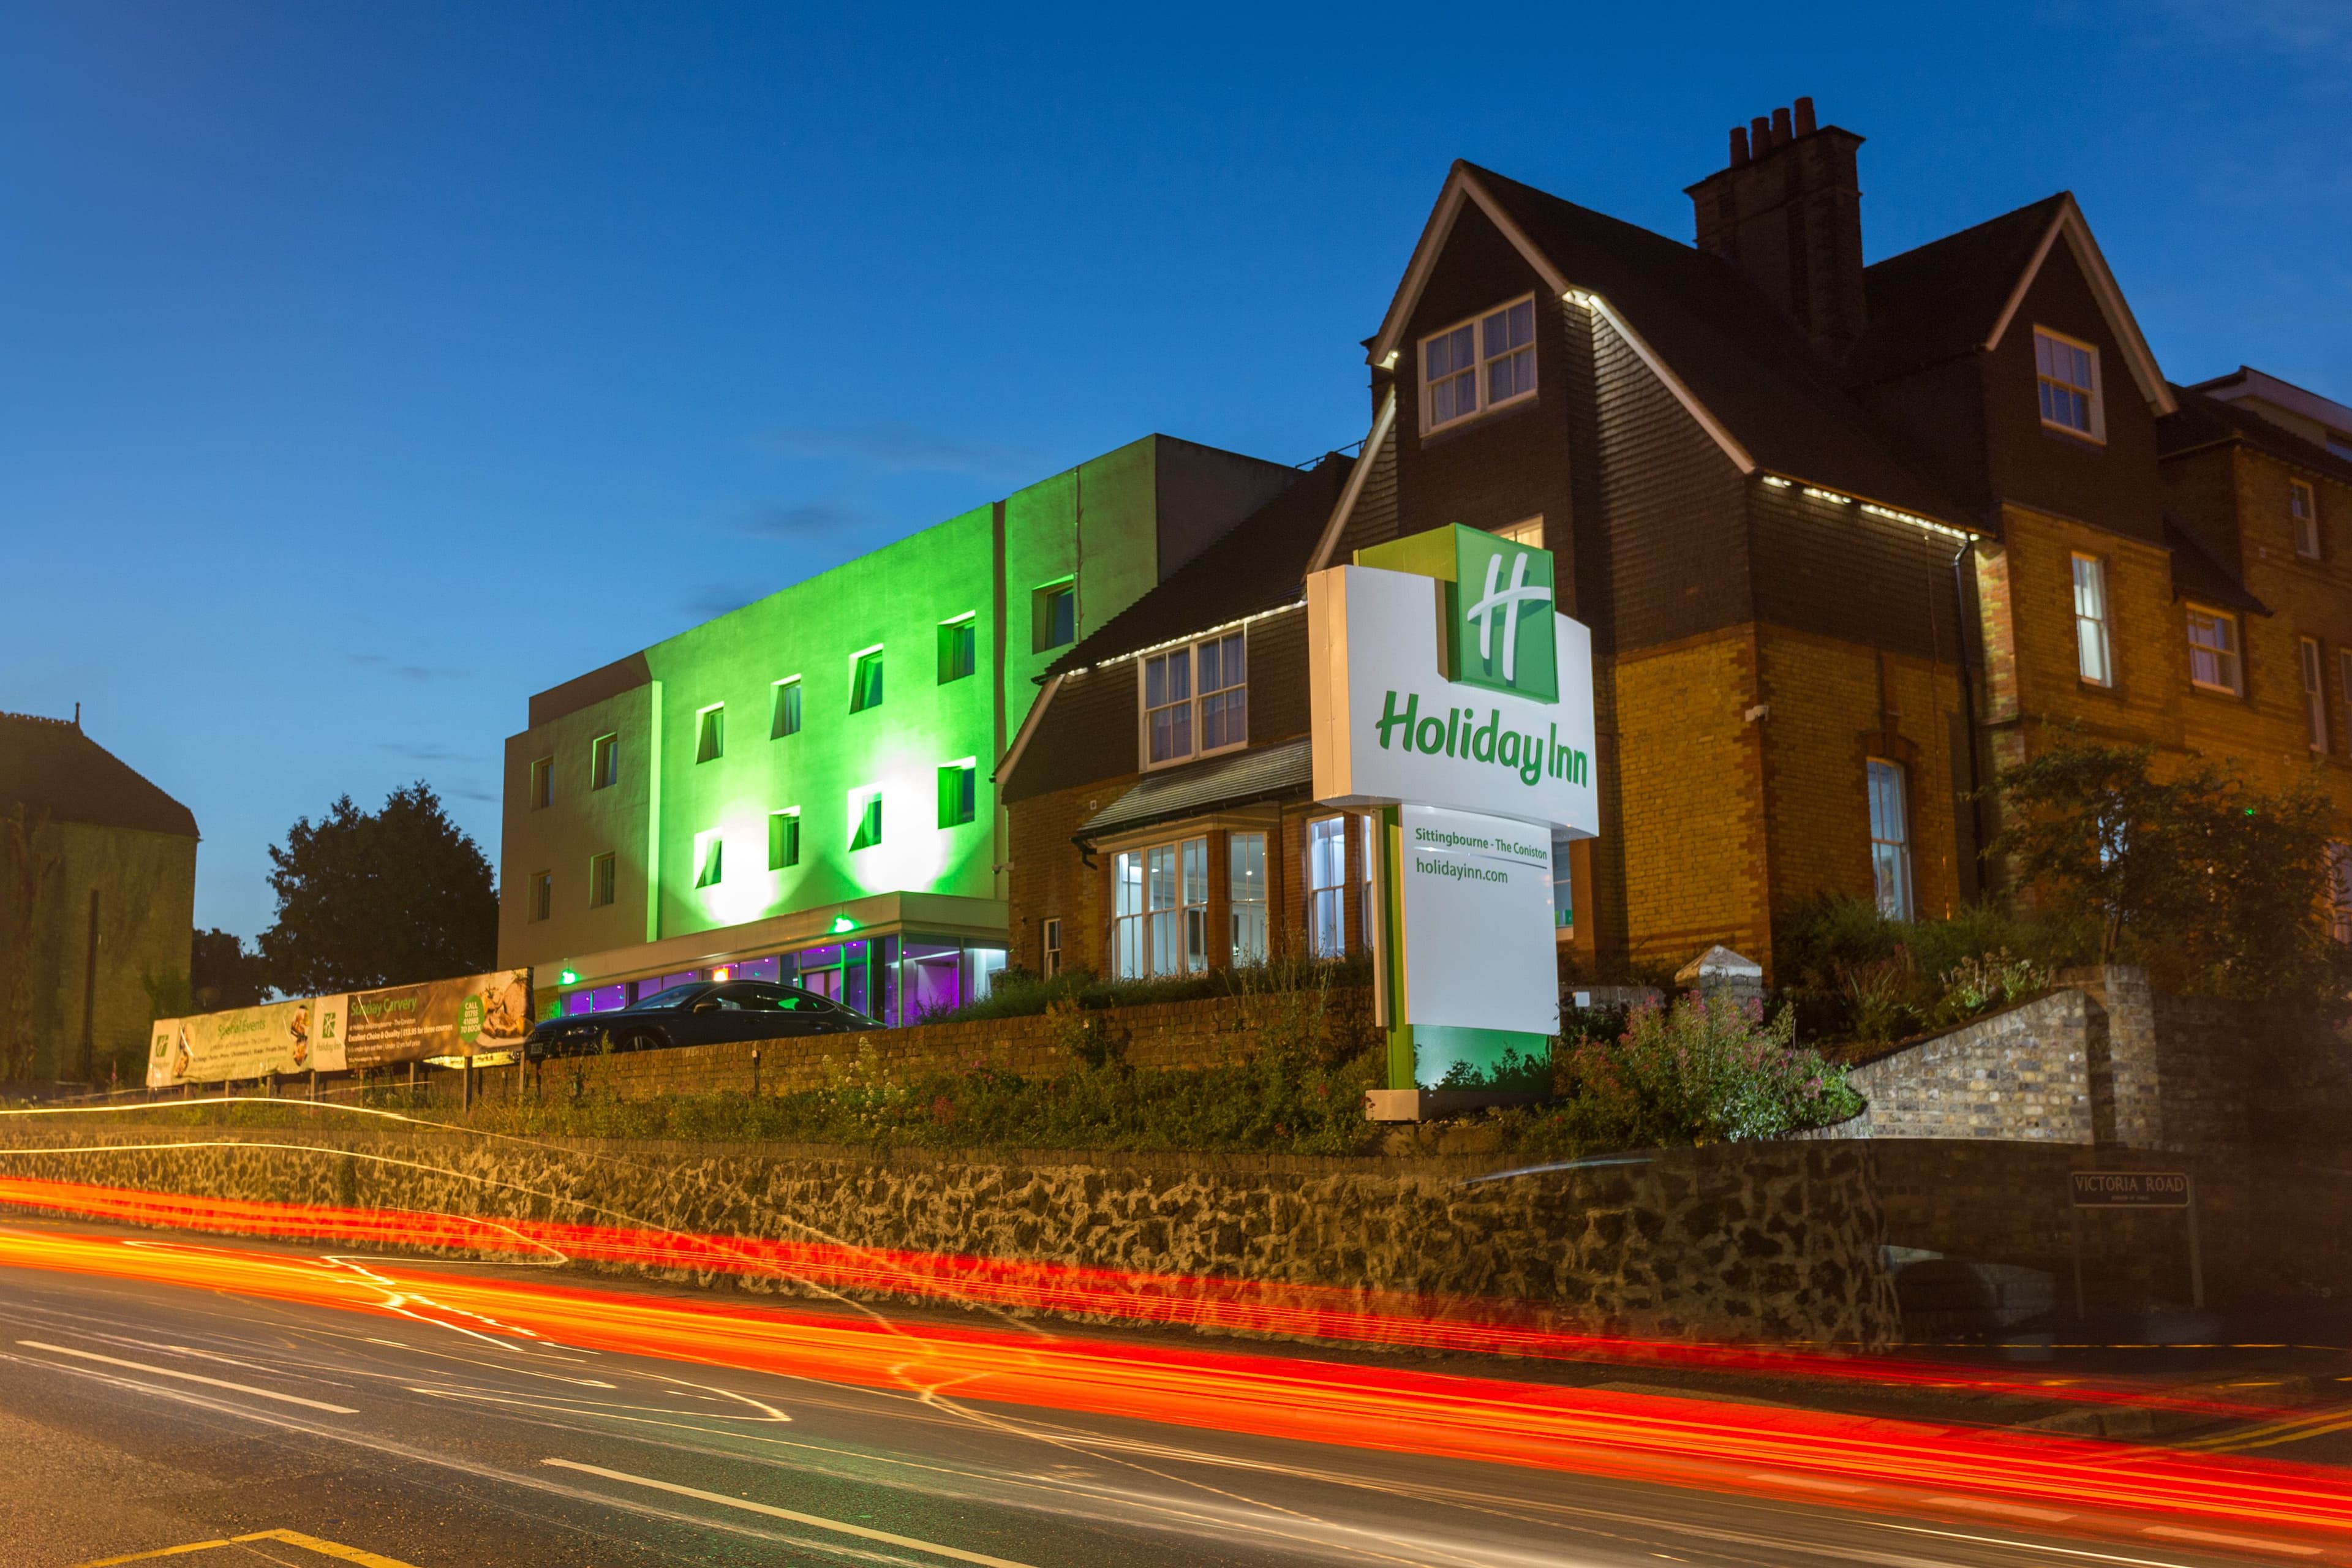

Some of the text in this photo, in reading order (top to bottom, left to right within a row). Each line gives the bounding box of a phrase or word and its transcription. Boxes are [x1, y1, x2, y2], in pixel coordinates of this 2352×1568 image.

[1375, 690, 1588, 788] Holiday Inn
[1415, 827, 1488, 849] Sittingbourne
[1495, 839, 1512, 853] The
[1513, 842, 1547, 860] Coniston
[1416, 857, 1508, 883] holidayinn.com
[465, 1001, 478, 1010] CALL
[243, 1019, 266, 1031] Events
[467, 1023, 481, 1033] BOOK
[2075, 1175, 2184, 1192] VICTORIA ROAD
